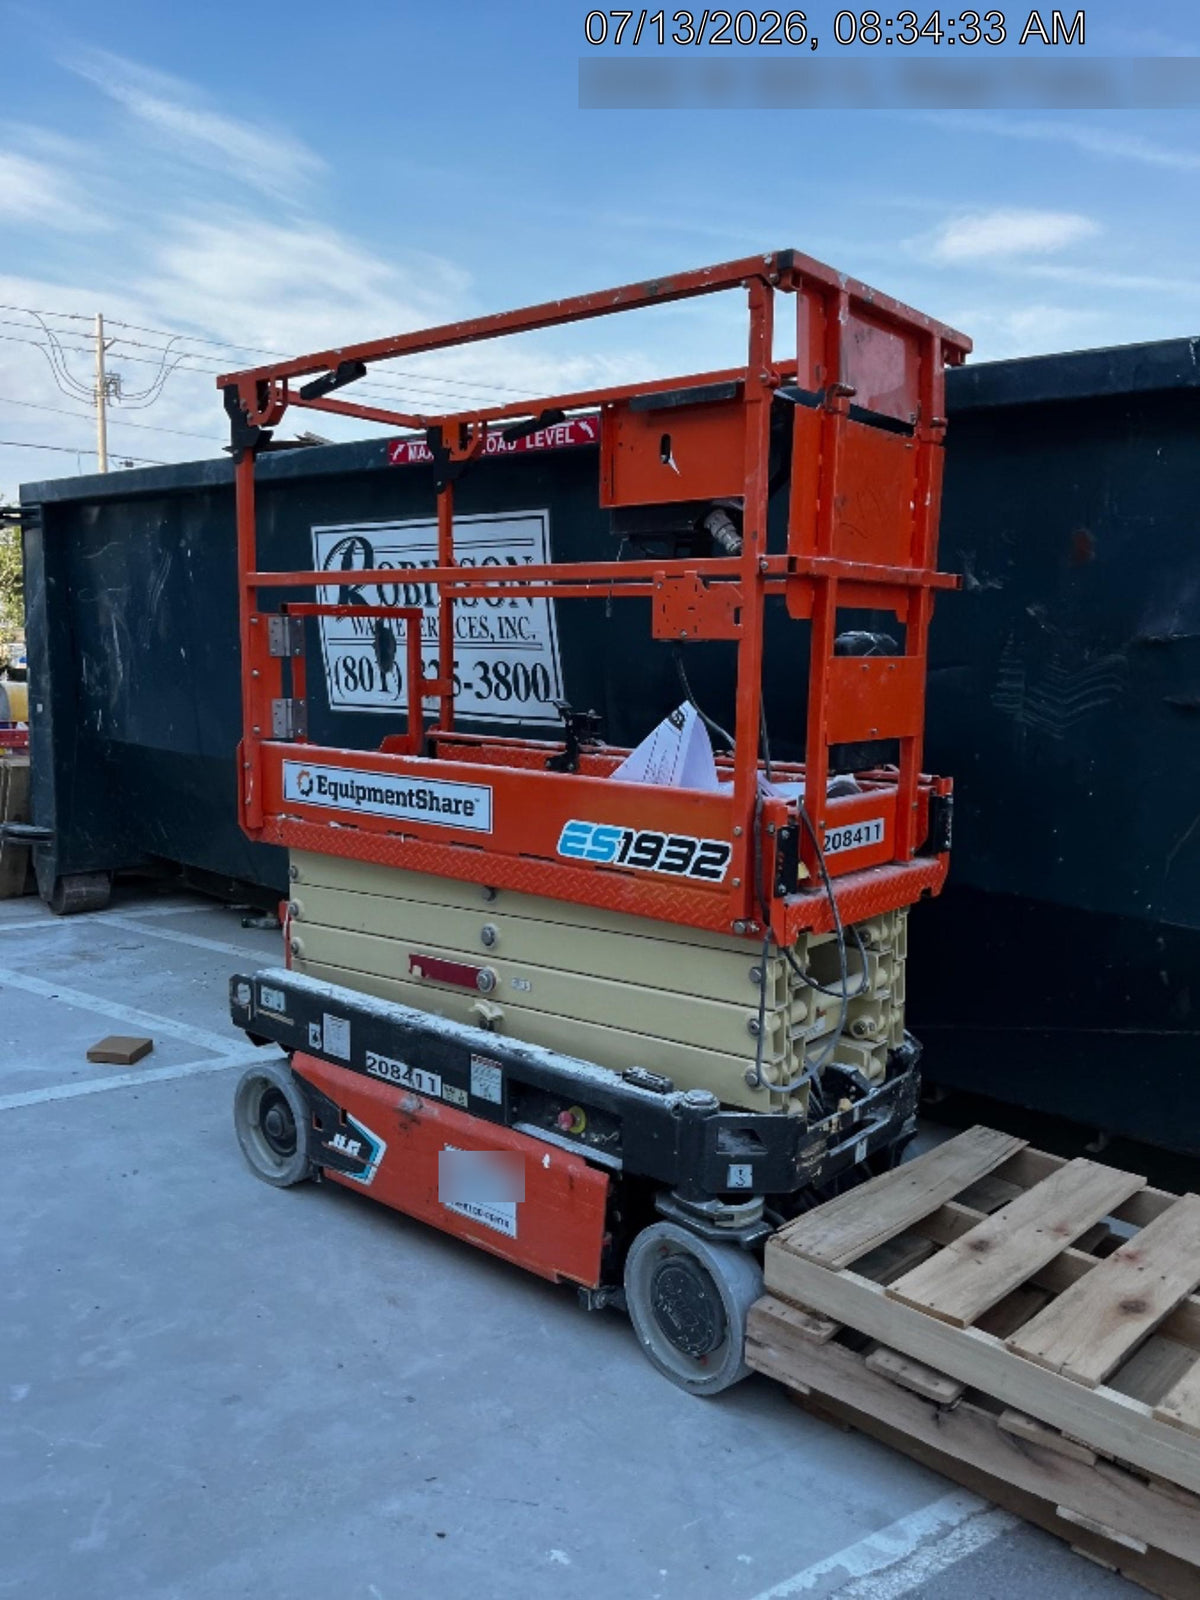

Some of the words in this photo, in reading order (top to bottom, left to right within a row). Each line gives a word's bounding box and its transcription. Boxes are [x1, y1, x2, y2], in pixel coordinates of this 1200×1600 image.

[525, 427, 575, 449] LEVEL
[351, 615, 406, 638] WATE
[498, 616, 536, 640] INC.
[316, 775, 475, 816] EquipmentShare
[558, 820, 732, 882] ES1932
[823, 823, 882, 852] 208411
[366, 1054, 437, 1093] 208411
